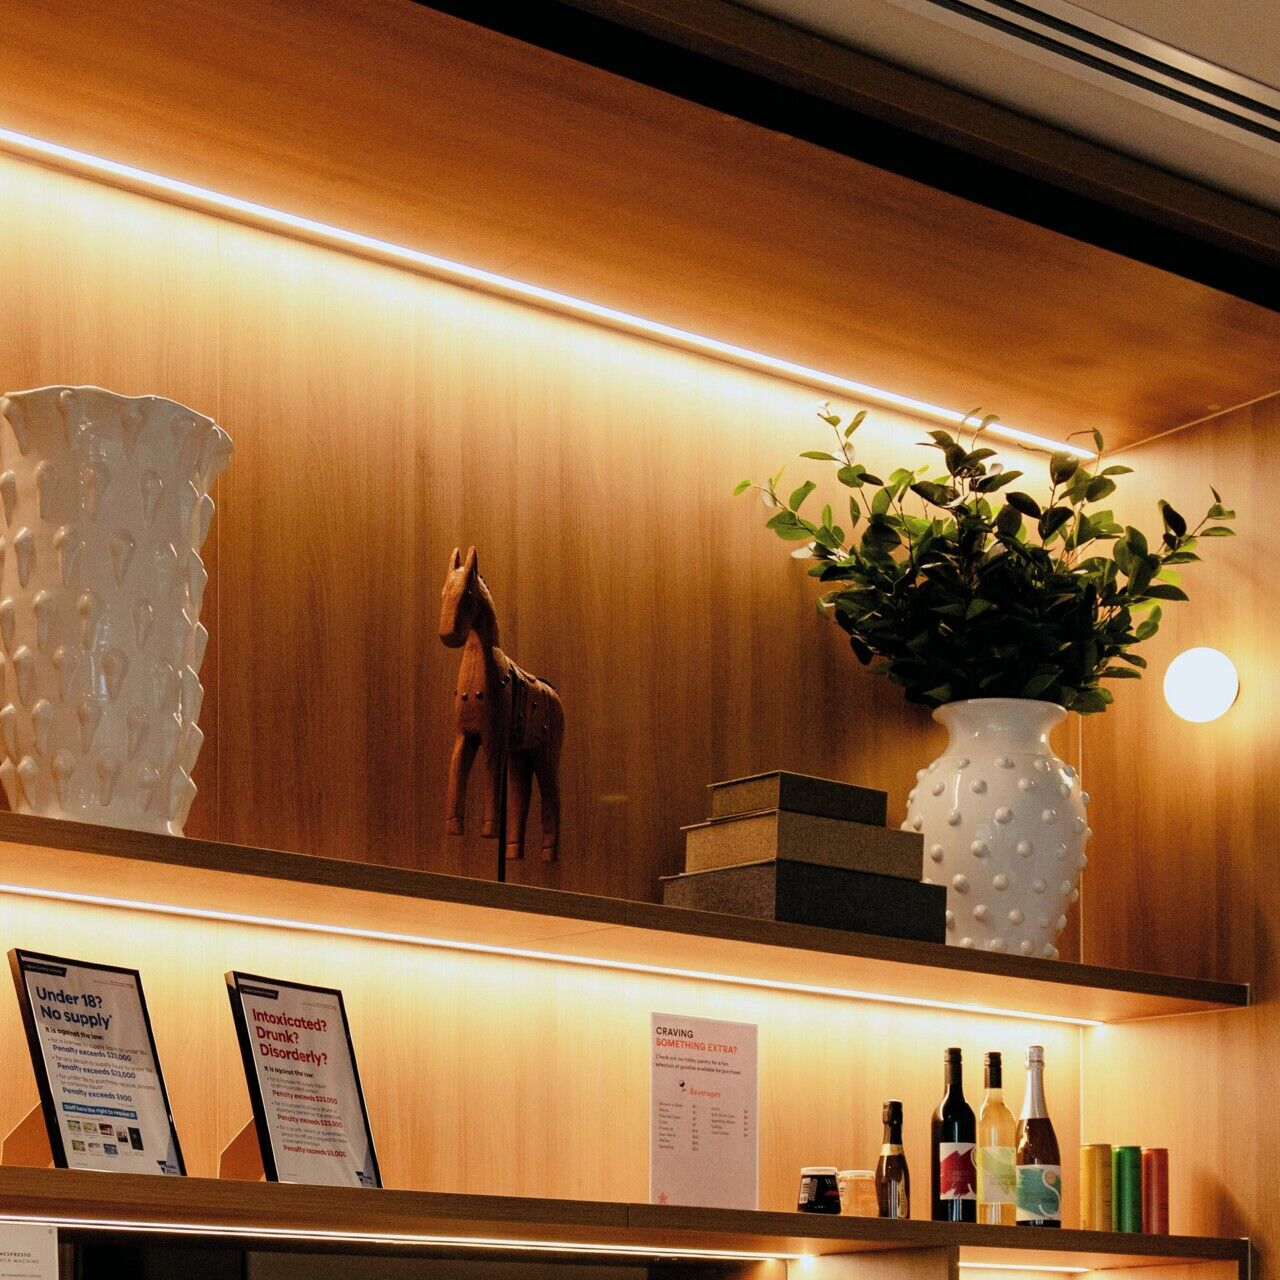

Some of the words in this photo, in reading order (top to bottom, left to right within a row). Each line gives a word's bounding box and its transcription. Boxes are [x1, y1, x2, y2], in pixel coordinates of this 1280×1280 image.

[36, 986, 79, 1005] Under
[81, 994, 103, 1008] 18?
[40, 1005, 62, 1020] No
[252, 1008, 327, 1032] Intoxicated?
[56, 1028, 80, 1037] against
[256, 1026, 299, 1044] Drunk?
[656, 1026, 694, 1039] CRAVING
[52, 1044, 77, 1054] Penalty
[78, 1048, 106, 1057] exceeds
[656, 1038, 706, 1051] SOMETHING
[708, 1043, 738, 1054] EXTRA?
[260, 1043, 328, 1067] Disorderly?
[56, 1062, 82, 1072] Penalty
[82, 1066, 109, 1075] exceeds
[62, 1087, 87, 1097] Penalty
[87, 1090, 115, 1099] exceeds
